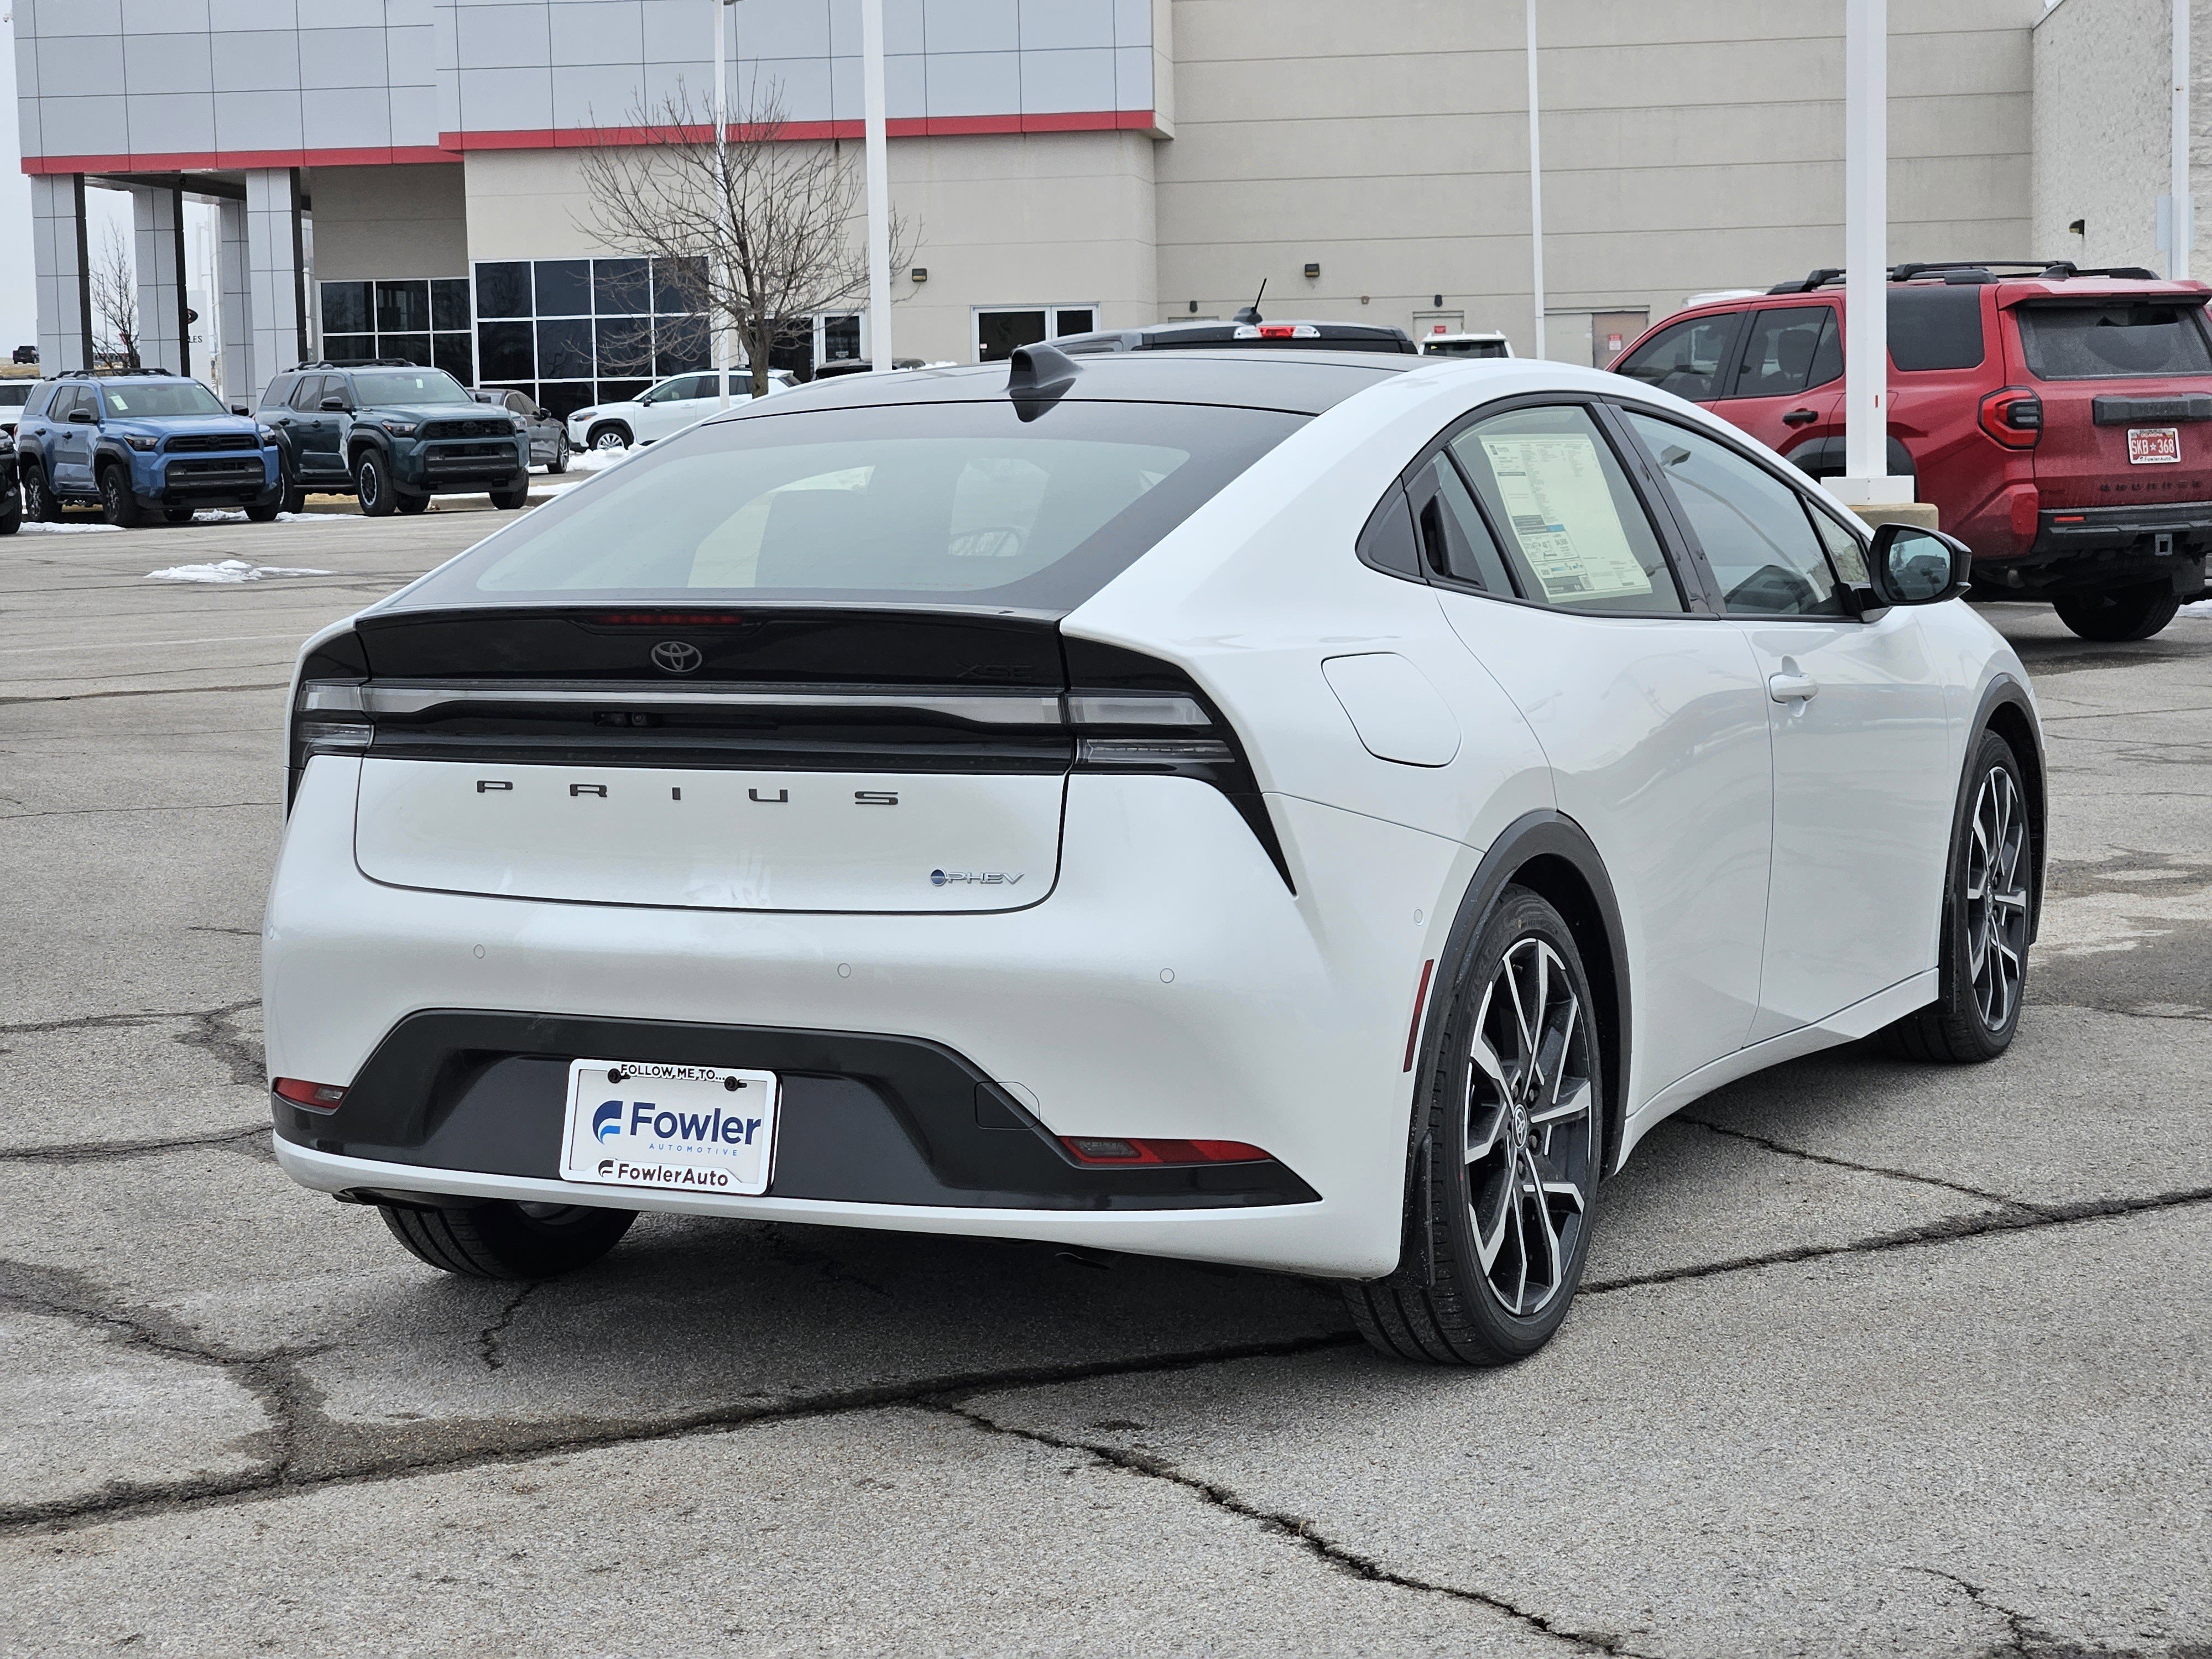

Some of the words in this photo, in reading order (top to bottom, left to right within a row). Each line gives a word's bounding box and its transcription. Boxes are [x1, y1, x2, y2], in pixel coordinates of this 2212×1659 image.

[2131, 439, 2149, 455] SKB
[2157, 438, 2175, 454] 368
[956, 662, 1034, 679] XSE
[476, 779, 899, 806] PRIUS
[947, 871, 1025, 885] PHEV
[620, 1063, 673, 1078] FOLLOW
[676, 1068, 695, 1078] ME
[629, 1102, 761, 1145] Fowler
[649, 1142, 739, 1156] AUTOMOTIVE
[617, 1162, 729, 1187] FowlerAuto
